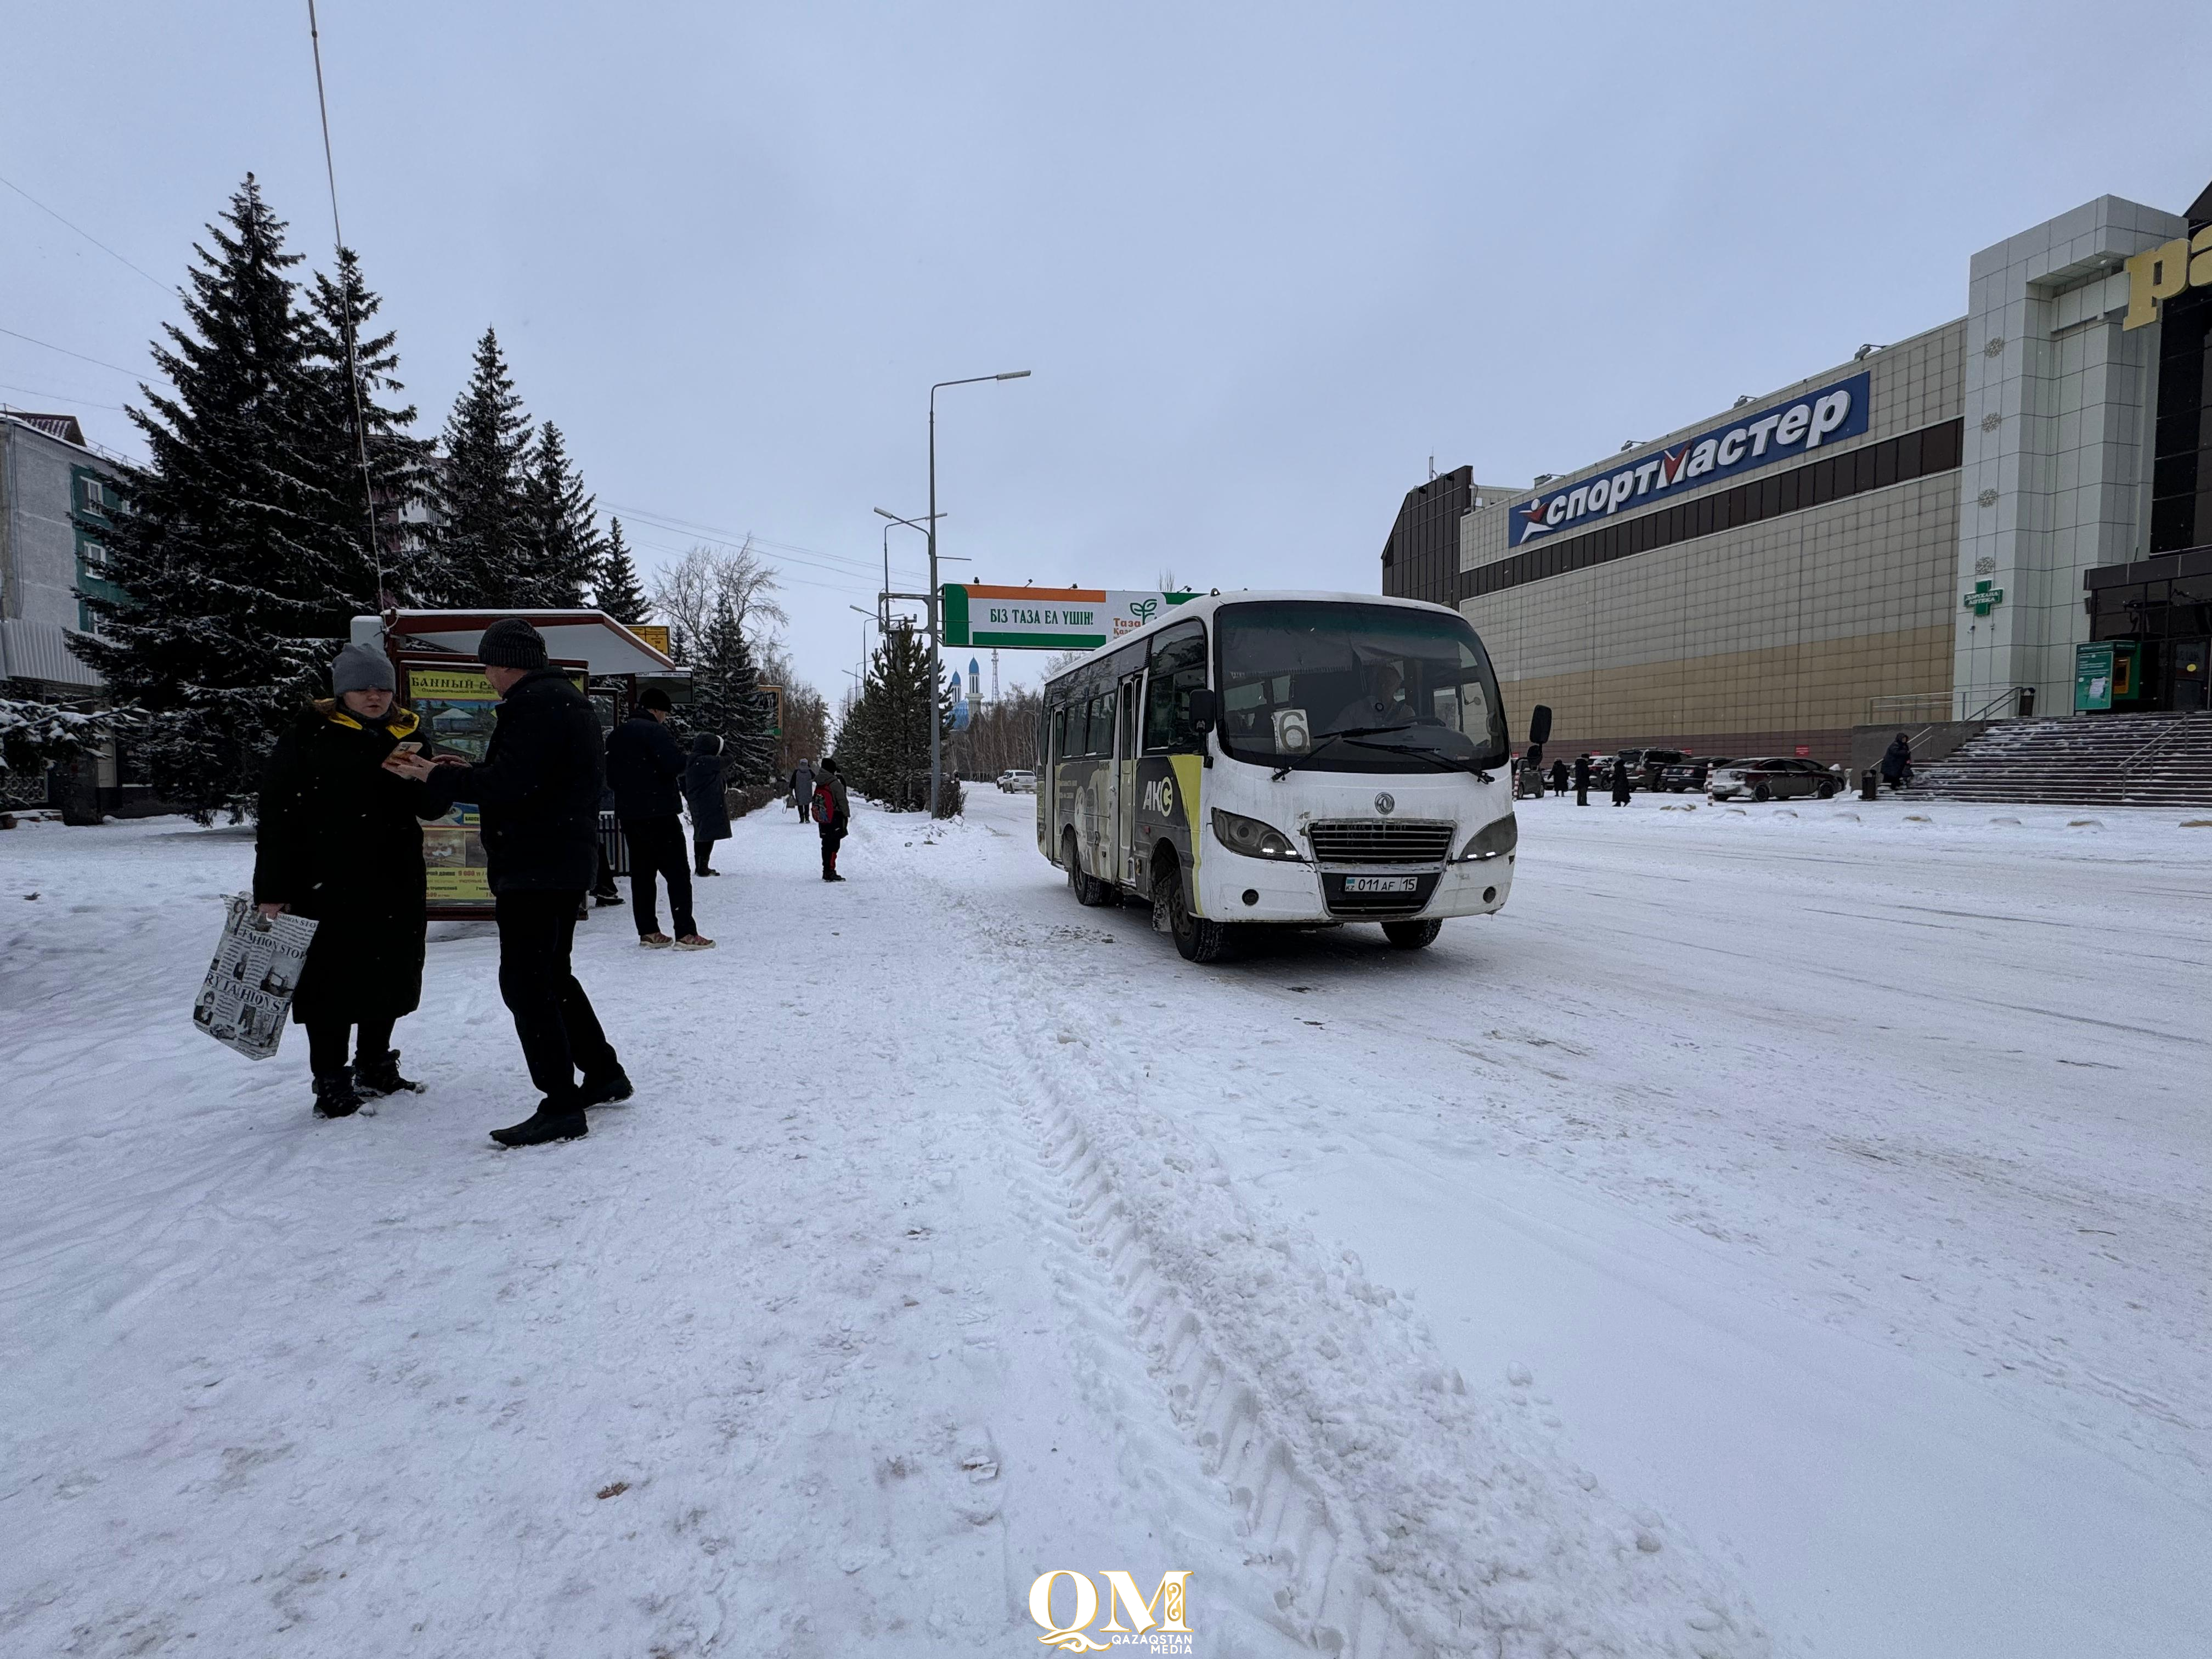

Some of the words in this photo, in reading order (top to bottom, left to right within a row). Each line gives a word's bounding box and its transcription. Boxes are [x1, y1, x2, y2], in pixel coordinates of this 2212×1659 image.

[990, 608, 1008, 623] БІЗ
[1012, 609, 1041, 623] ТАЗА
[1045, 610, 1058, 624] ЕЛ
[1063, 610, 1093, 625] ҮШІН!
[1113, 618, 1141, 628] Таза
[412, 677, 473, 689] БАННЫЙ
[1279, 711, 1308, 753] 6
[1358, 879, 1379, 891] 011
[1381, 882, 1396, 891] AF
[1403, 879, 1415, 890] 15
